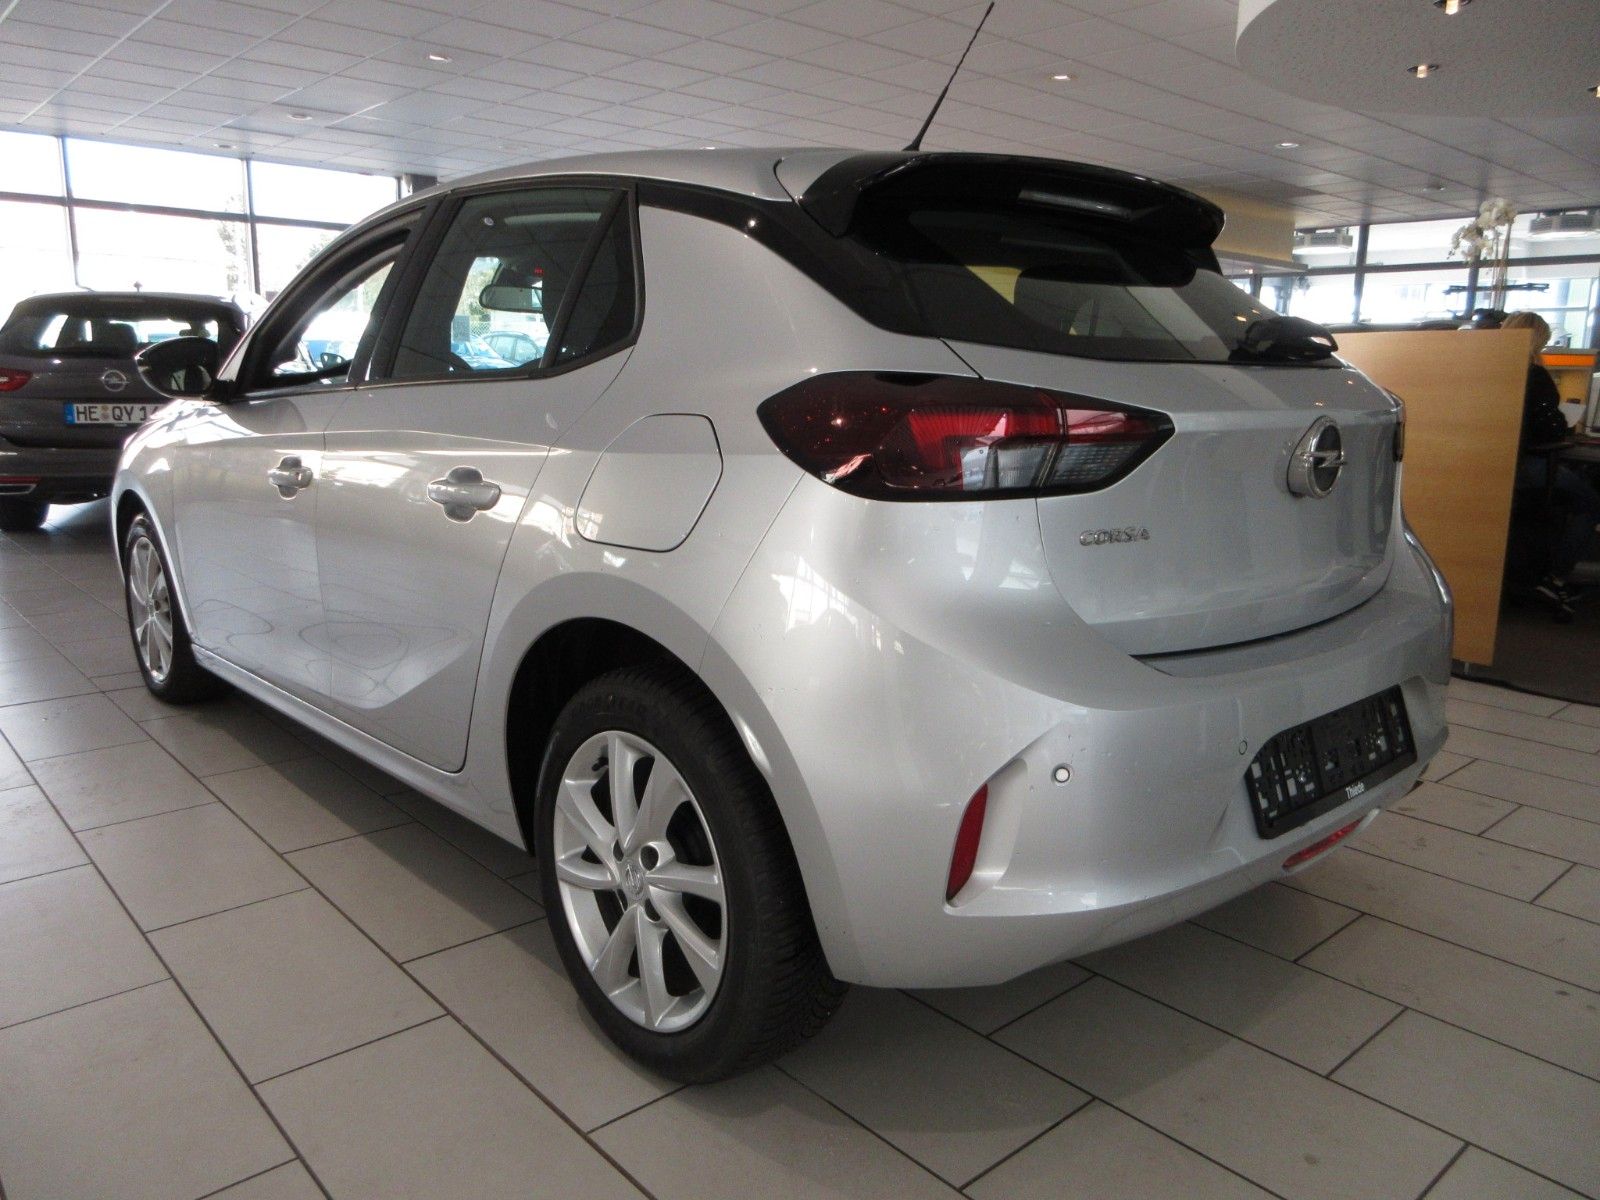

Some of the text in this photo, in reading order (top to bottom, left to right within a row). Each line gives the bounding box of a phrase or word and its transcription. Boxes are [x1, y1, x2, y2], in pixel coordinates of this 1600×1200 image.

[76, 406, 99, 421] HE
[112, 406, 134, 421] QY
[1080, 527, 1150, 546] CORSA
